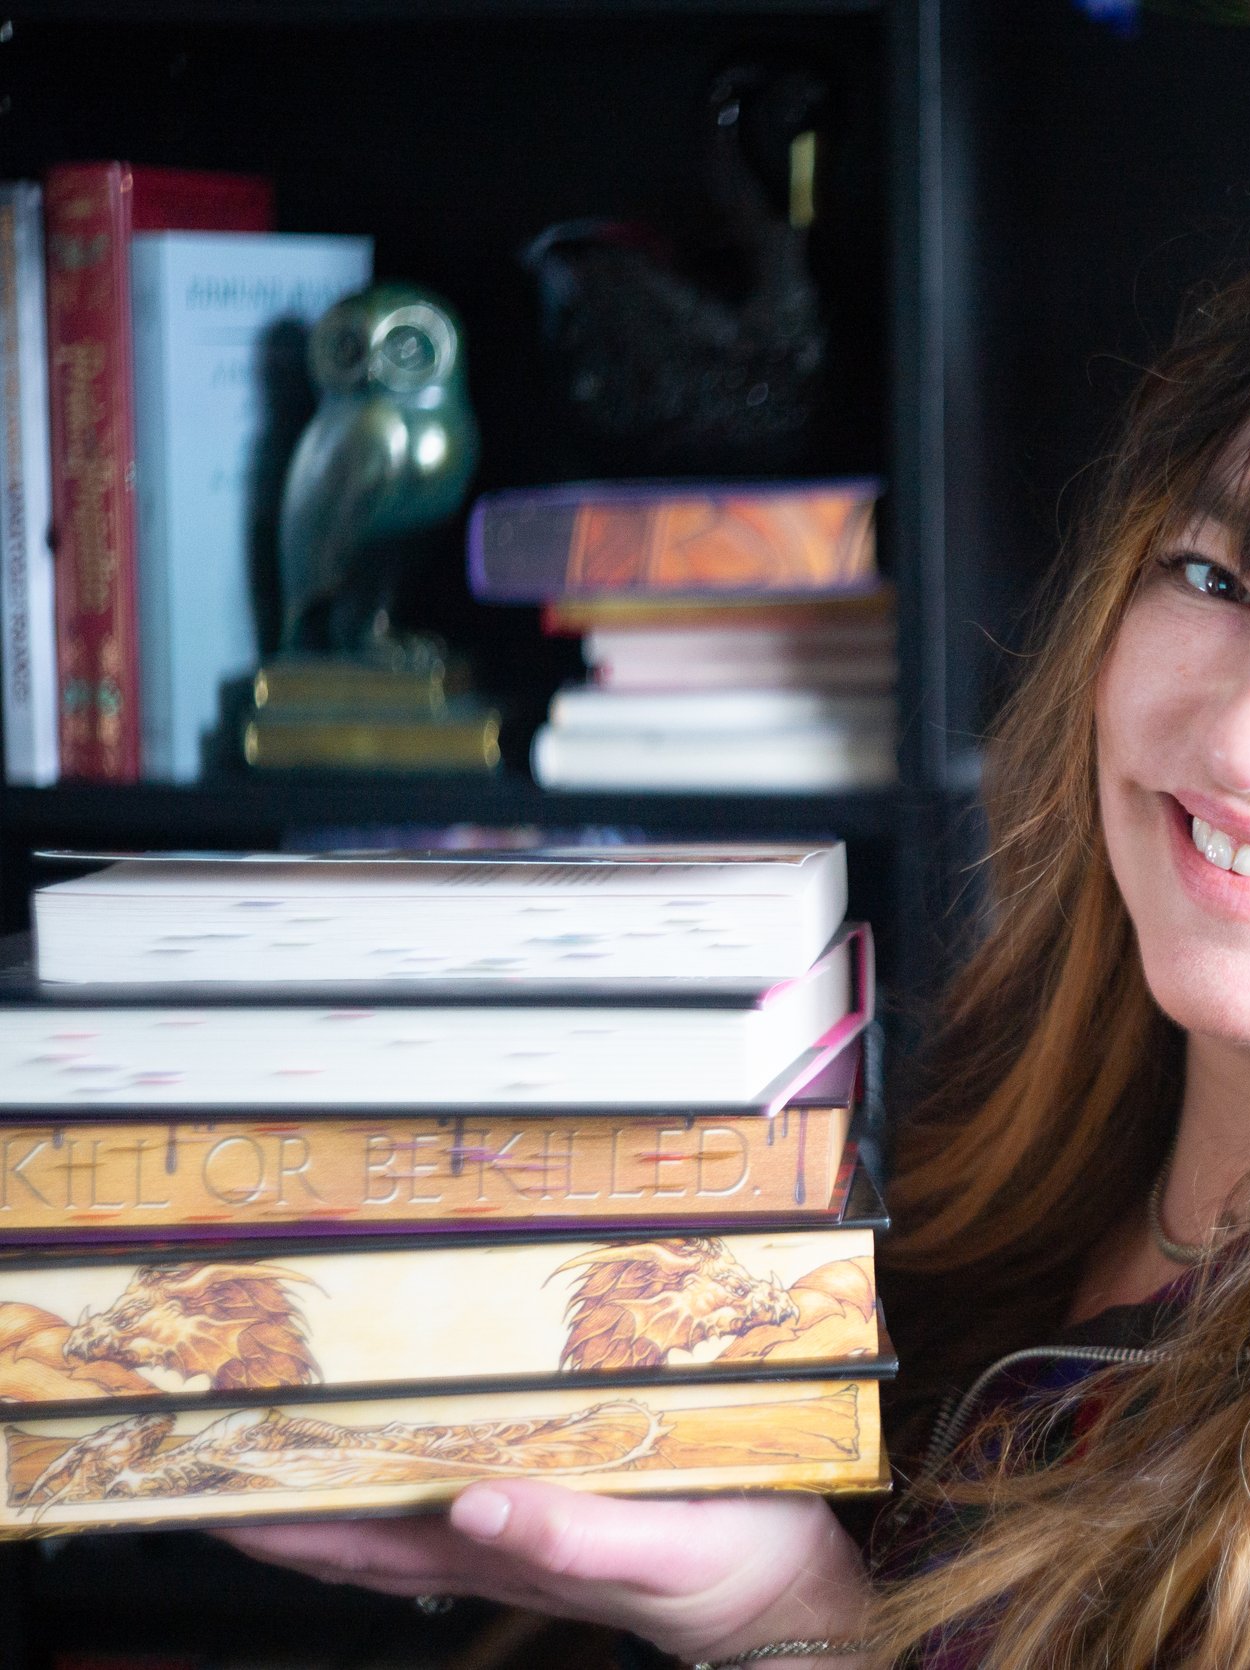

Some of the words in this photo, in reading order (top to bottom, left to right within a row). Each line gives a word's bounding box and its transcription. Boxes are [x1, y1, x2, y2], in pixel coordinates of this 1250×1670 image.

[0, 1137, 171, 1210] KILL
[202, 1133, 331, 1208] OR
[362, 1131, 443, 1206] BE
[474, 1126, 763, 1203] KILLED.
